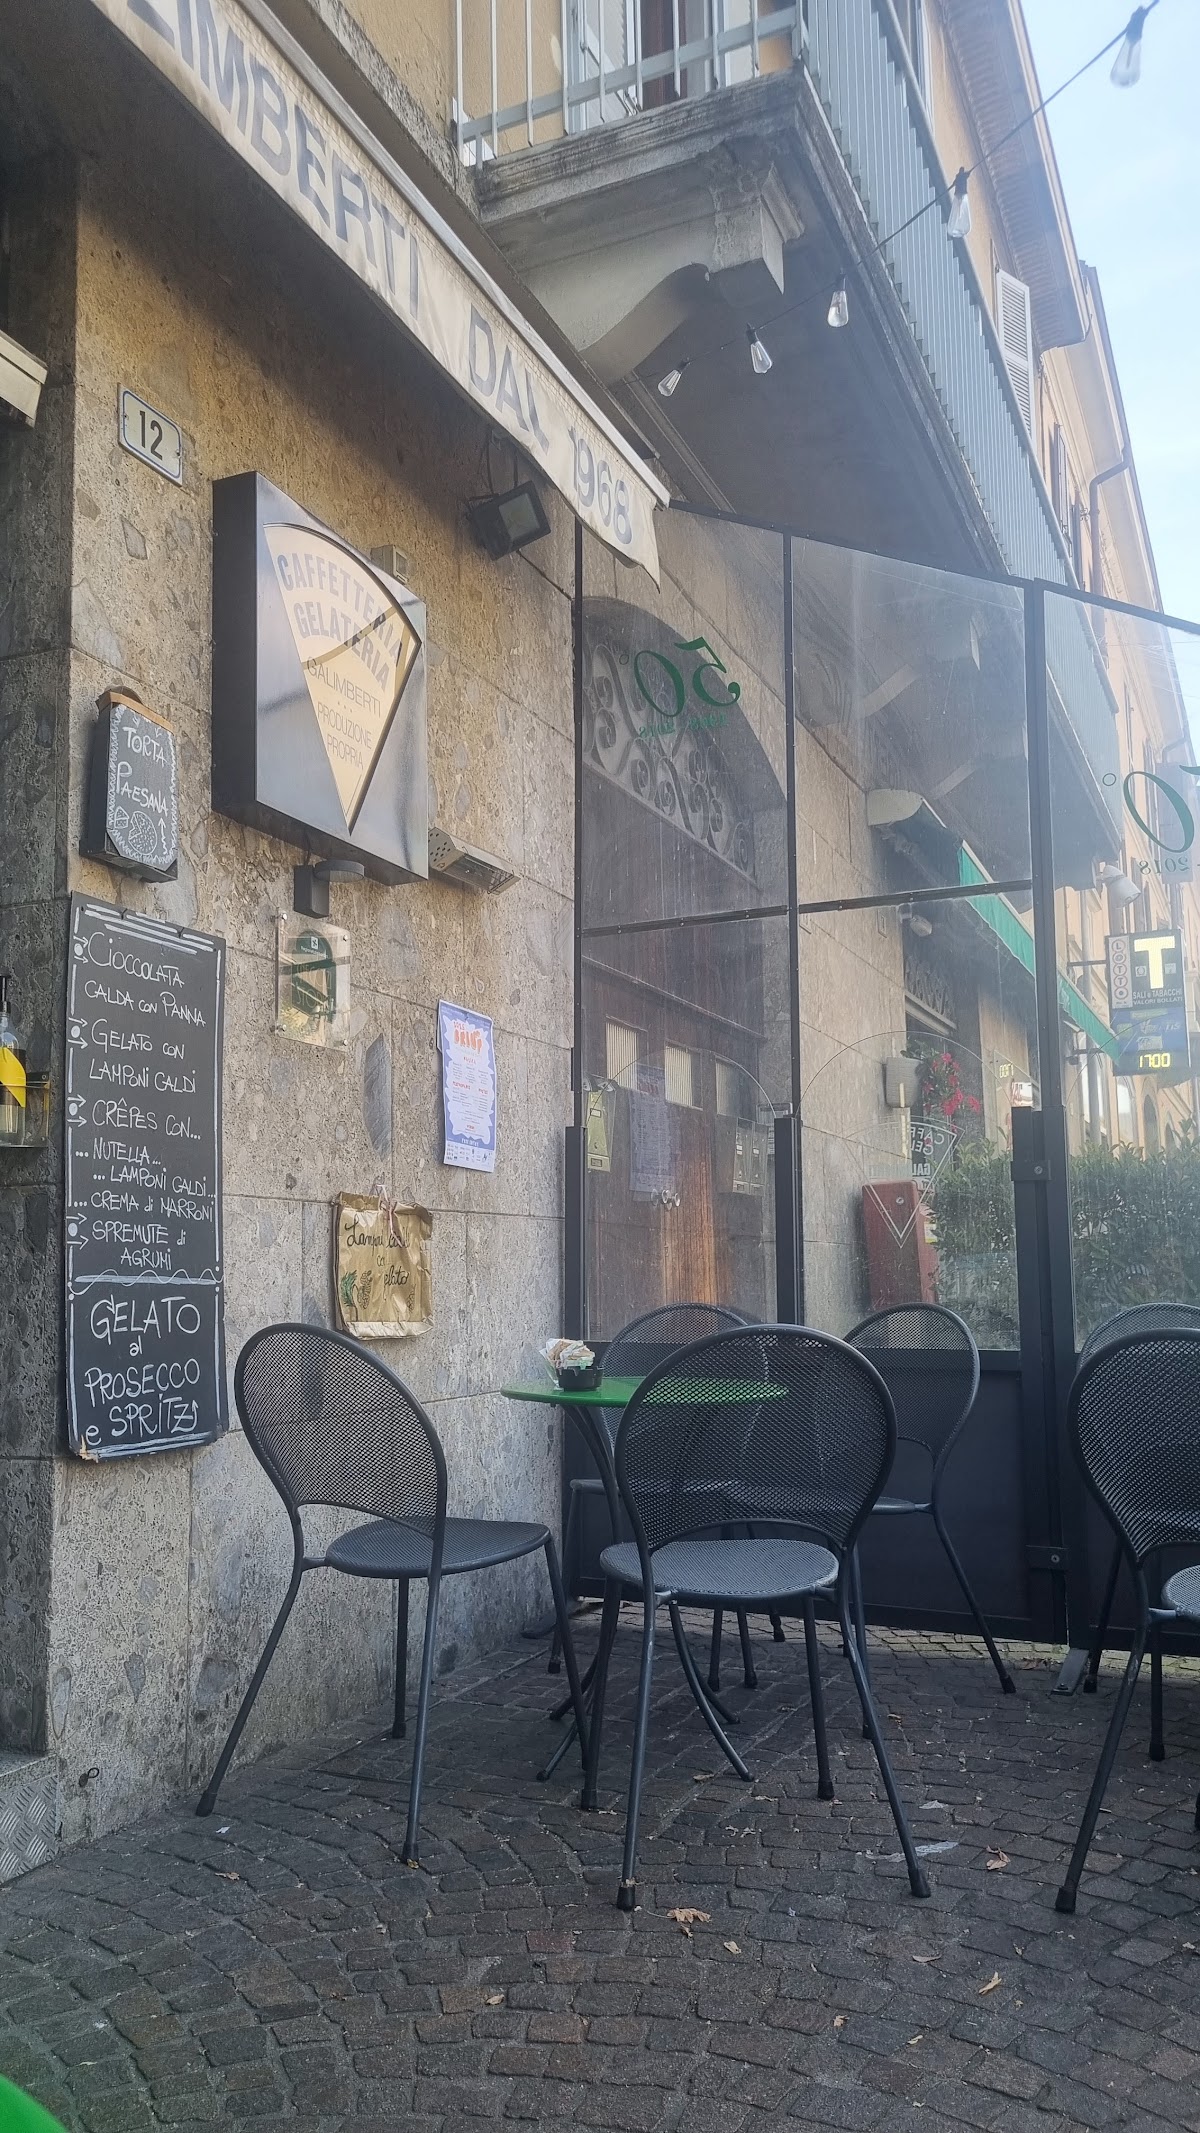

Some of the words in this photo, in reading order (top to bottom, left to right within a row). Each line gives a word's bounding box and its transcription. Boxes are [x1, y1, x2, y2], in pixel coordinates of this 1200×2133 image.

[139, 410, 163, 461] 12
[468, 302, 550, 456] DAL
[567, 425, 633, 545] 1968
[277, 553, 403, 668] CAFFETTERIA
[293, 602, 390, 693] GELATERIA
[306, 656, 381, 718] GALIMBERTI
[122, 726, 167, 768] TORTA
[317, 701, 372, 750] PRODUZIONE
[326, 733, 364, 771] PROPRIA
[116, 761, 169, 817] PAESANA
[87, 931, 186, 988] CIOCCOLATA
[1113, 940, 1129, 1000] LOTTO
[1133, 935, 1176, 990] T
[84, 979, 135, 1011] CALDA
[159, 991, 207, 1027] PANNA
[1132, 990, 1147, 1000] SALI
[1151, 988, 1183, 998] TABACCHI
[91, 1018, 153, 1054] GELATO
[89, 1058, 150, 1088] LAMPONI
[154, 1069, 197, 1093] CALDI
[92, 1097, 158, 1131] CRÊPES
[91, 1220, 169, 1245] SPREMUTE
[120, 1246, 173, 1271] AGRUMI
[90, 1294, 201, 1346] GELATO
[83, 1358, 201, 1408] PROSECCO
